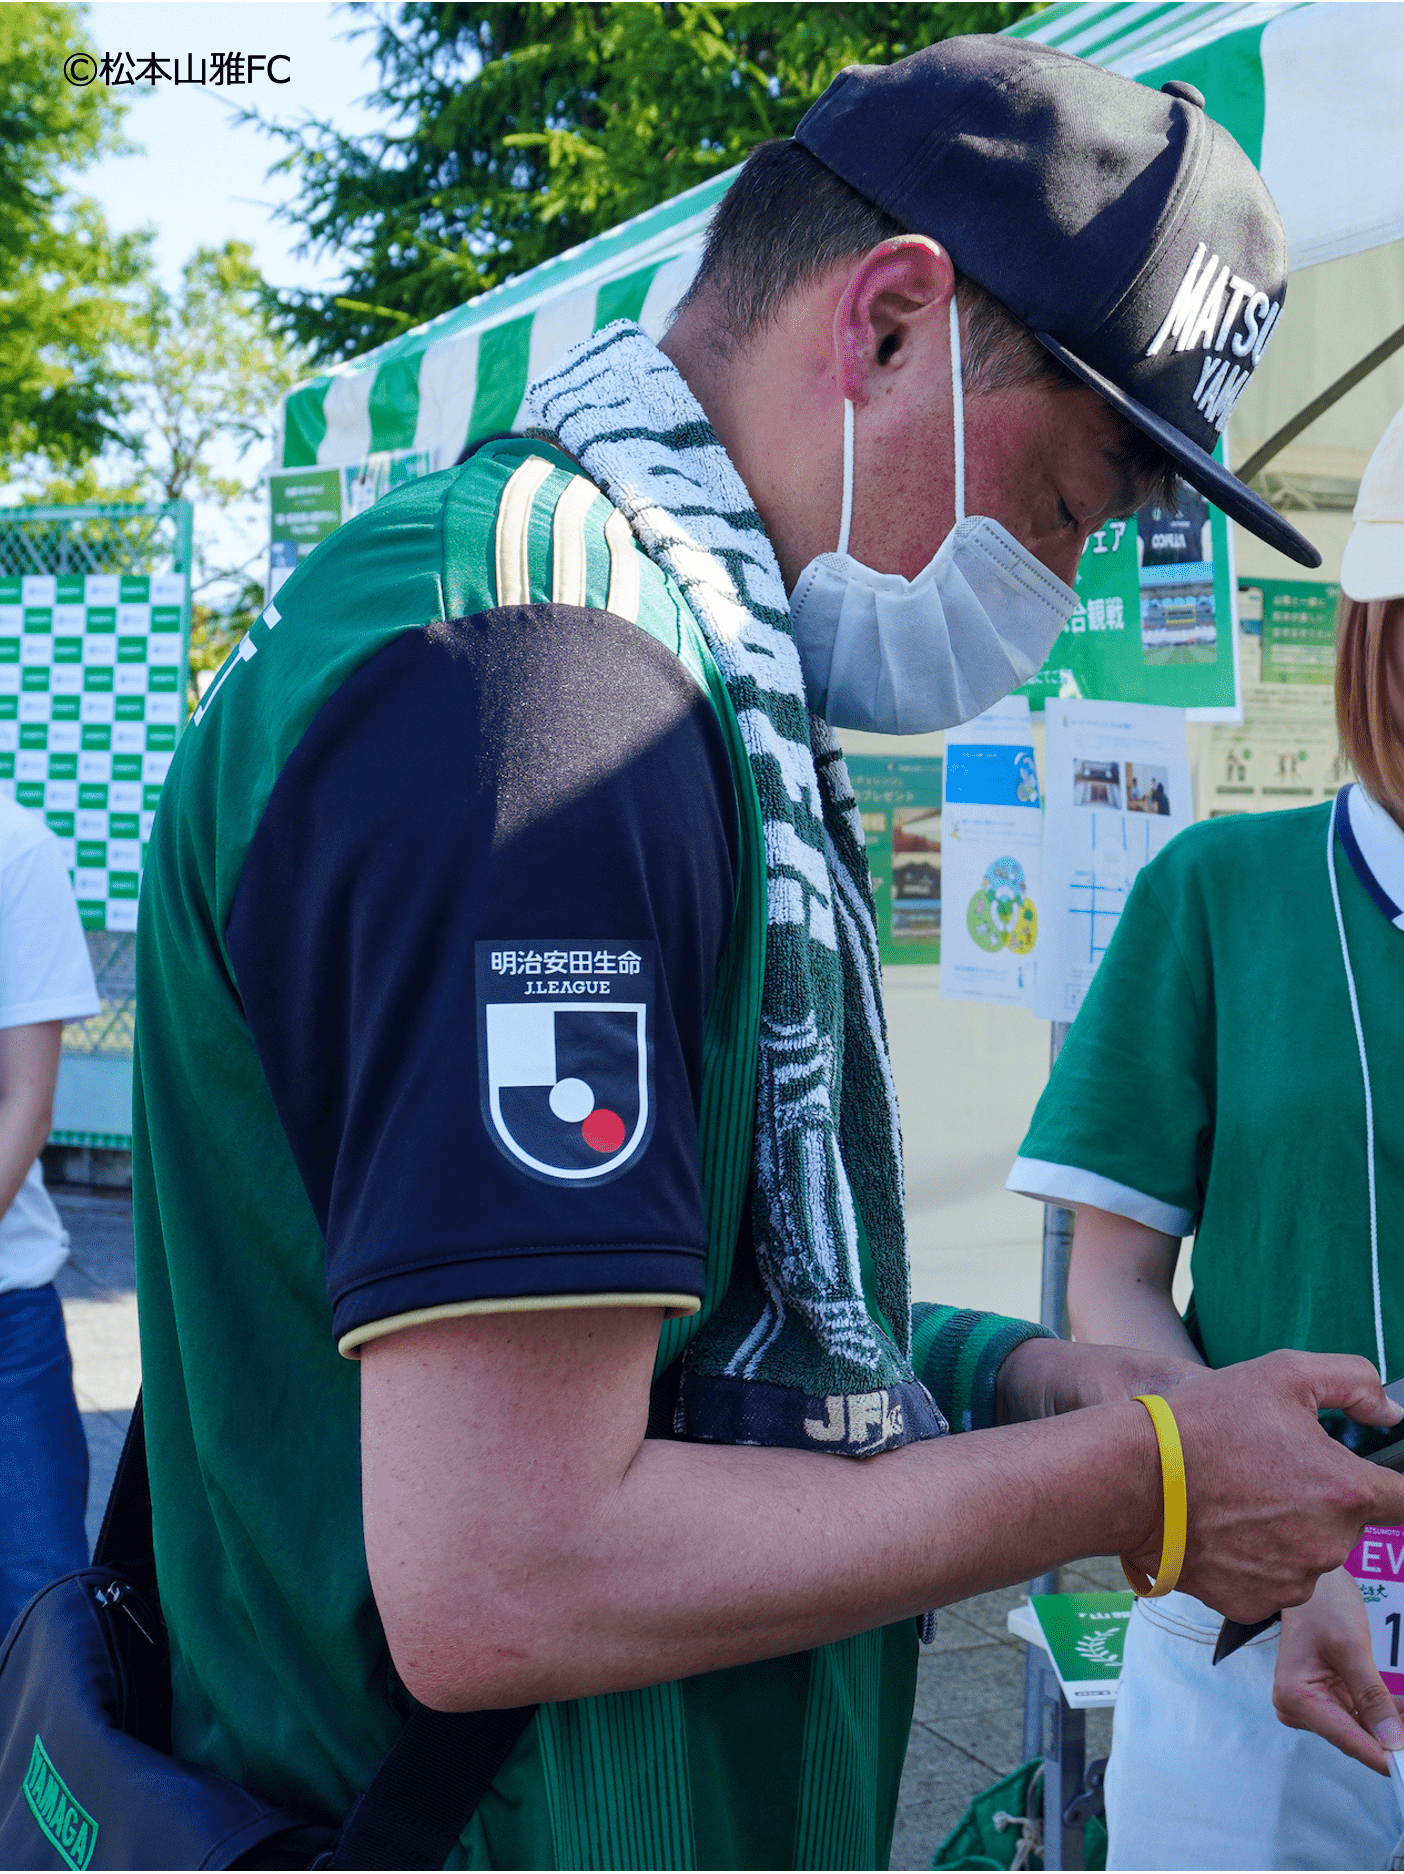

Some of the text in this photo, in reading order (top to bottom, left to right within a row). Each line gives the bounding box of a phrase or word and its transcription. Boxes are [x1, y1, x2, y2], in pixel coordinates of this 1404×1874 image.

[1064, 597, 1125, 633] 合観戦
[490, 950, 642, 976] 明治安田生命
[524, 980, 611, 995] J.LEAGUE
[29, 1746, 88, 1866] YAMAGA
